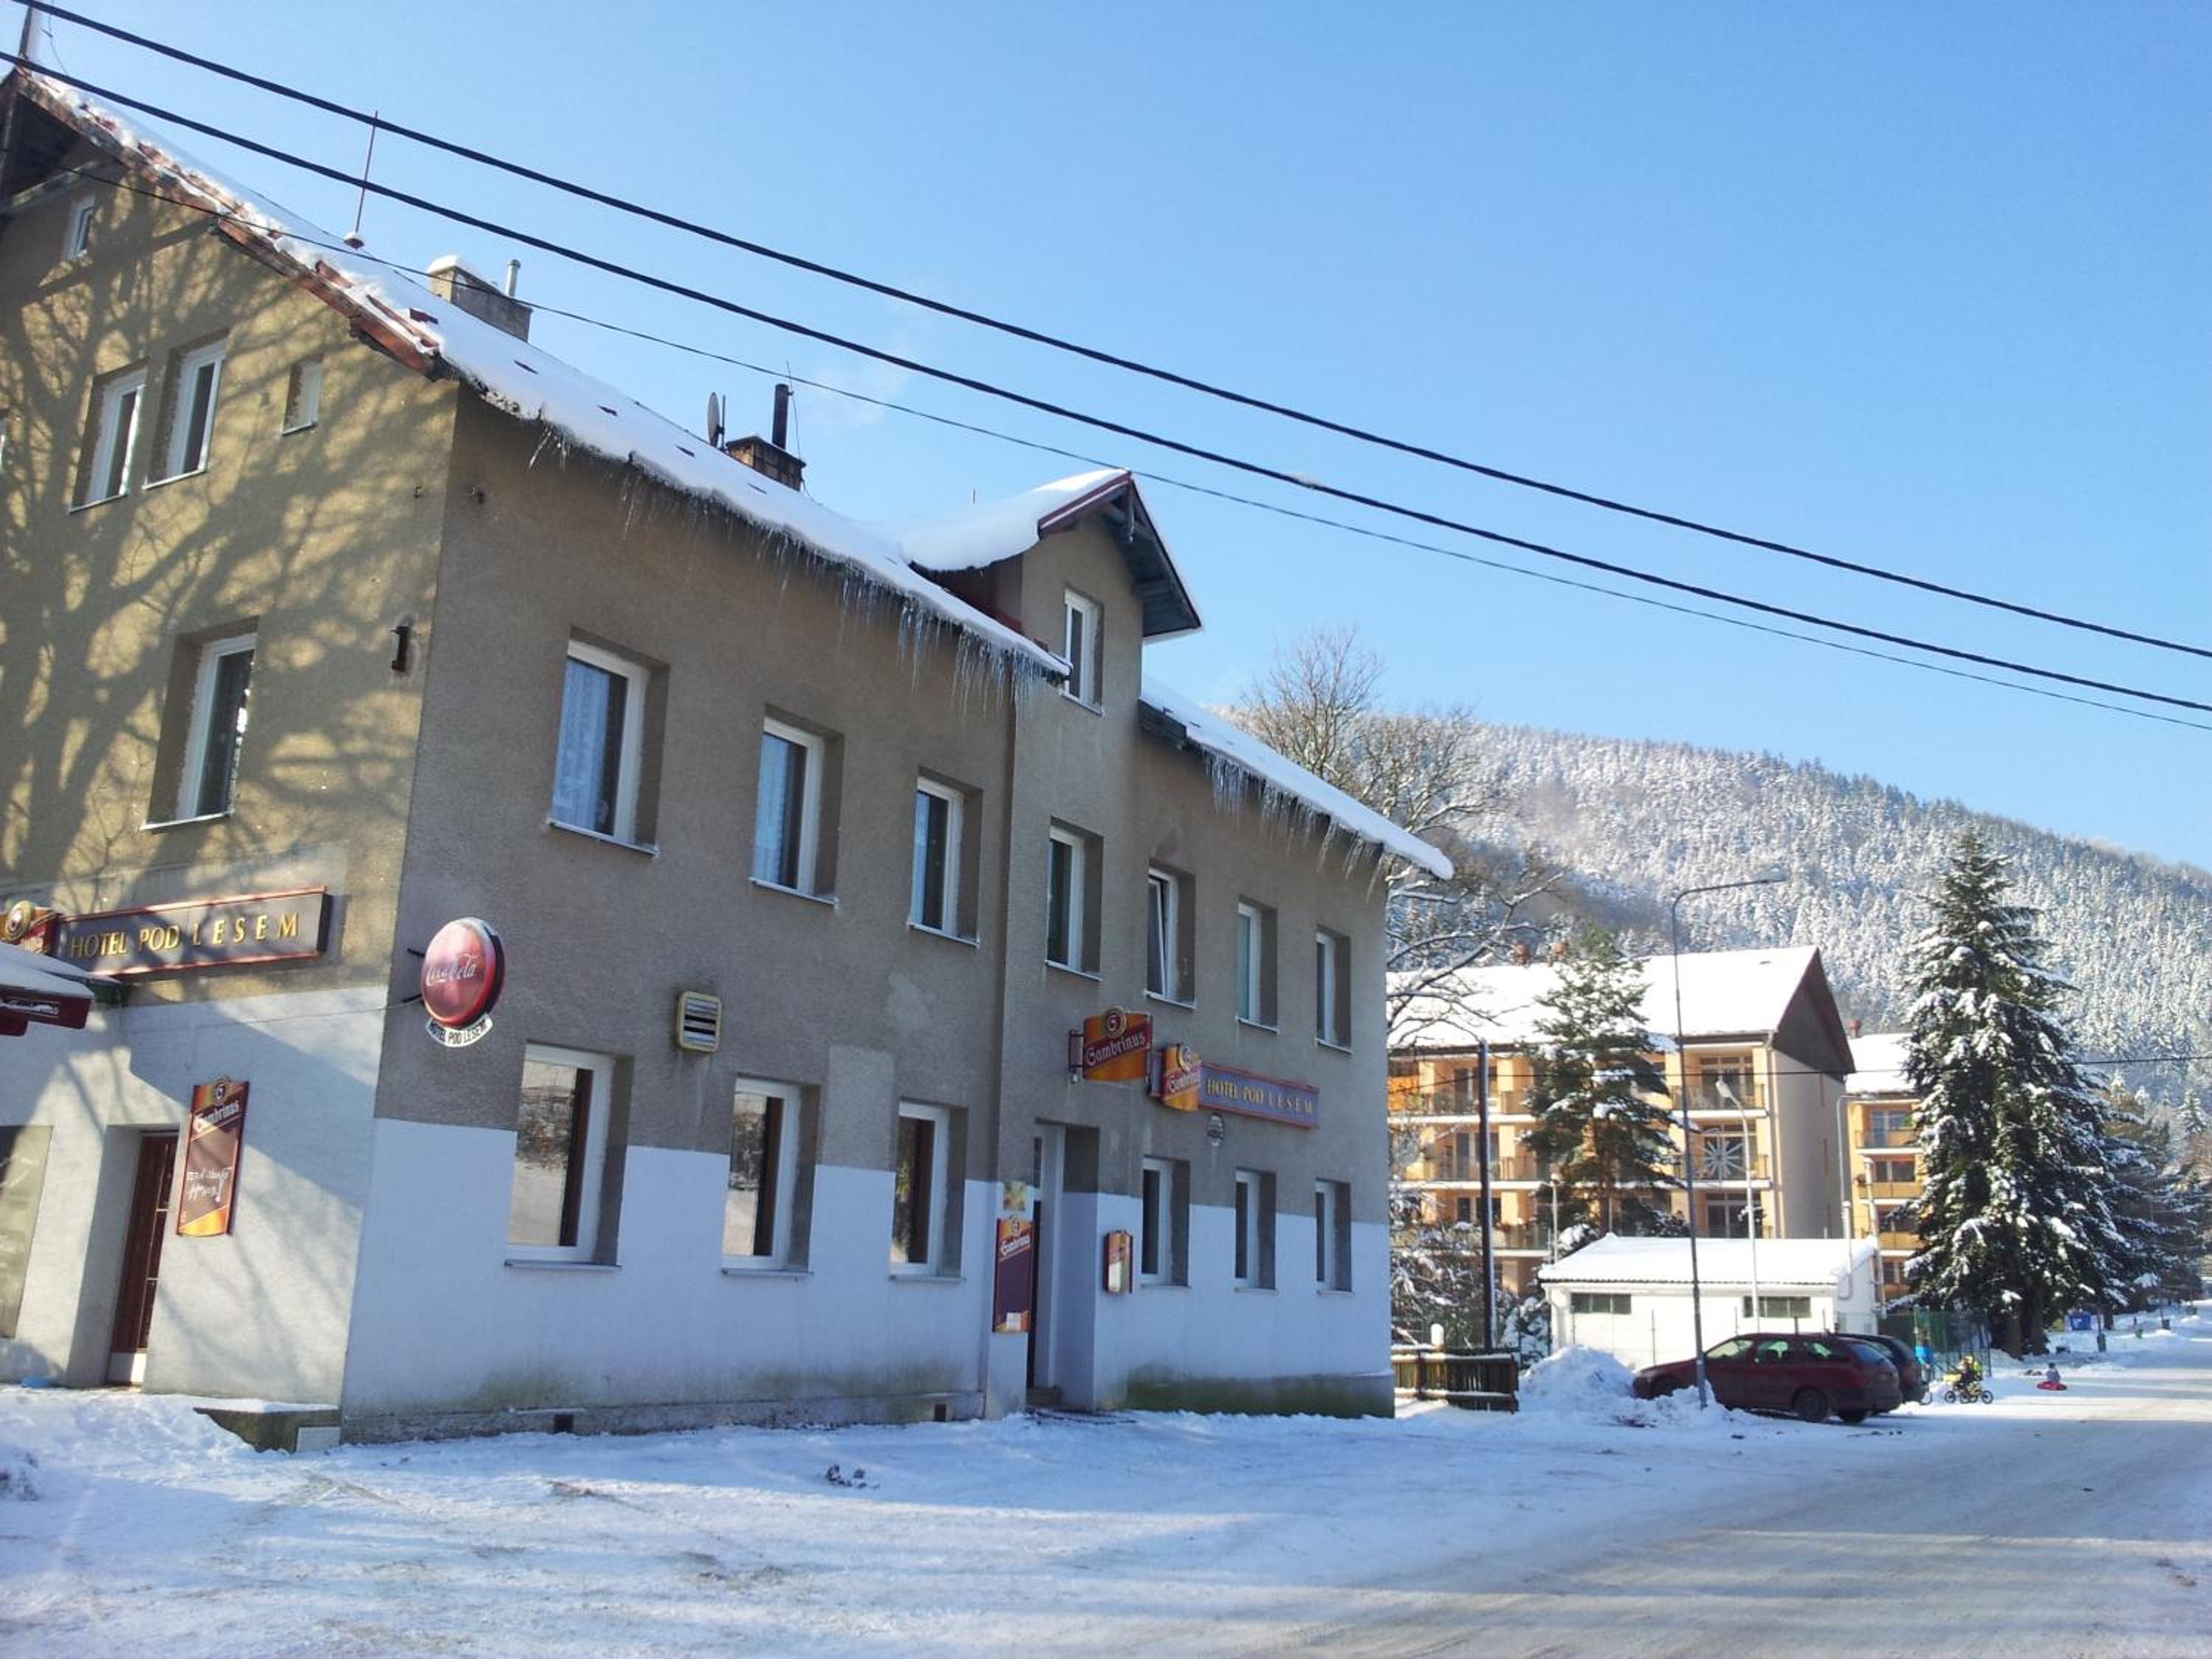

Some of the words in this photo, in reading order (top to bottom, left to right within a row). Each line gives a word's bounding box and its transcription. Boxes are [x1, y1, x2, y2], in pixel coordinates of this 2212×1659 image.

[71, 931, 128, 958] HOTEL
[139, 925, 181, 951] POD
[192, 911, 299, 946] LESEM
[1085, 1032, 1145, 1066] Gambrinus
